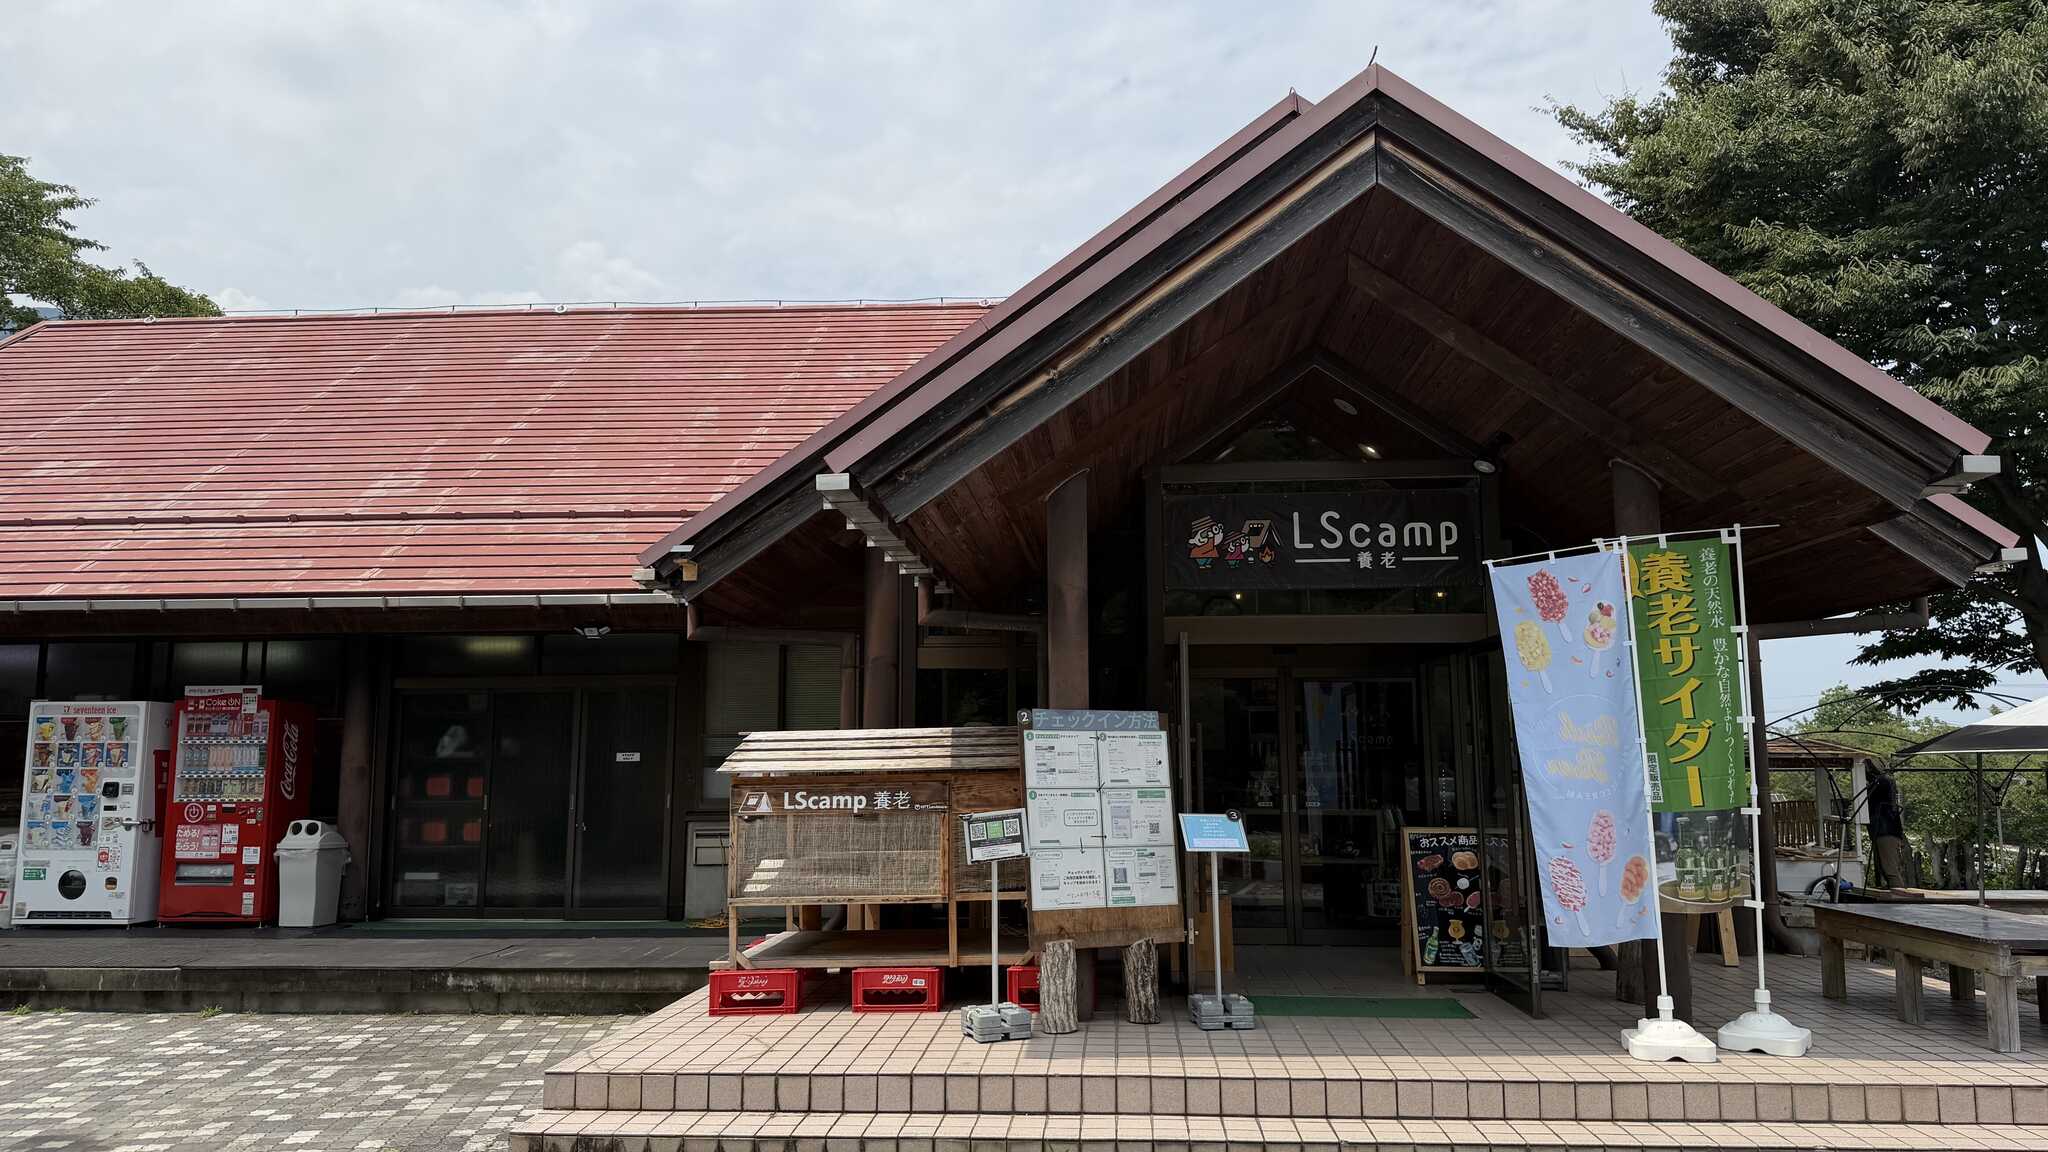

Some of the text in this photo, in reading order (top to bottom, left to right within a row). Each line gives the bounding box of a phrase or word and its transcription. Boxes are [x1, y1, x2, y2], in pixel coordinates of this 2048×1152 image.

[1292, 510, 1459, 554] LScamp
[1356, 551, 1397, 569] 養老
[1699, 548, 1725, 628] 養老の天然水
[1640, 551, 1714, 807] 養老サイダー
[73, 706, 105, 715] seventeen
[106, 706, 117, 714] ice
[1034, 711, 1158, 729] チェックイン方法
[280, 720, 299, 800] Coca-Cola
[784, 791, 912, 813] LScamp 養老
[1420, 835, 1479, 848] おススメ商品
